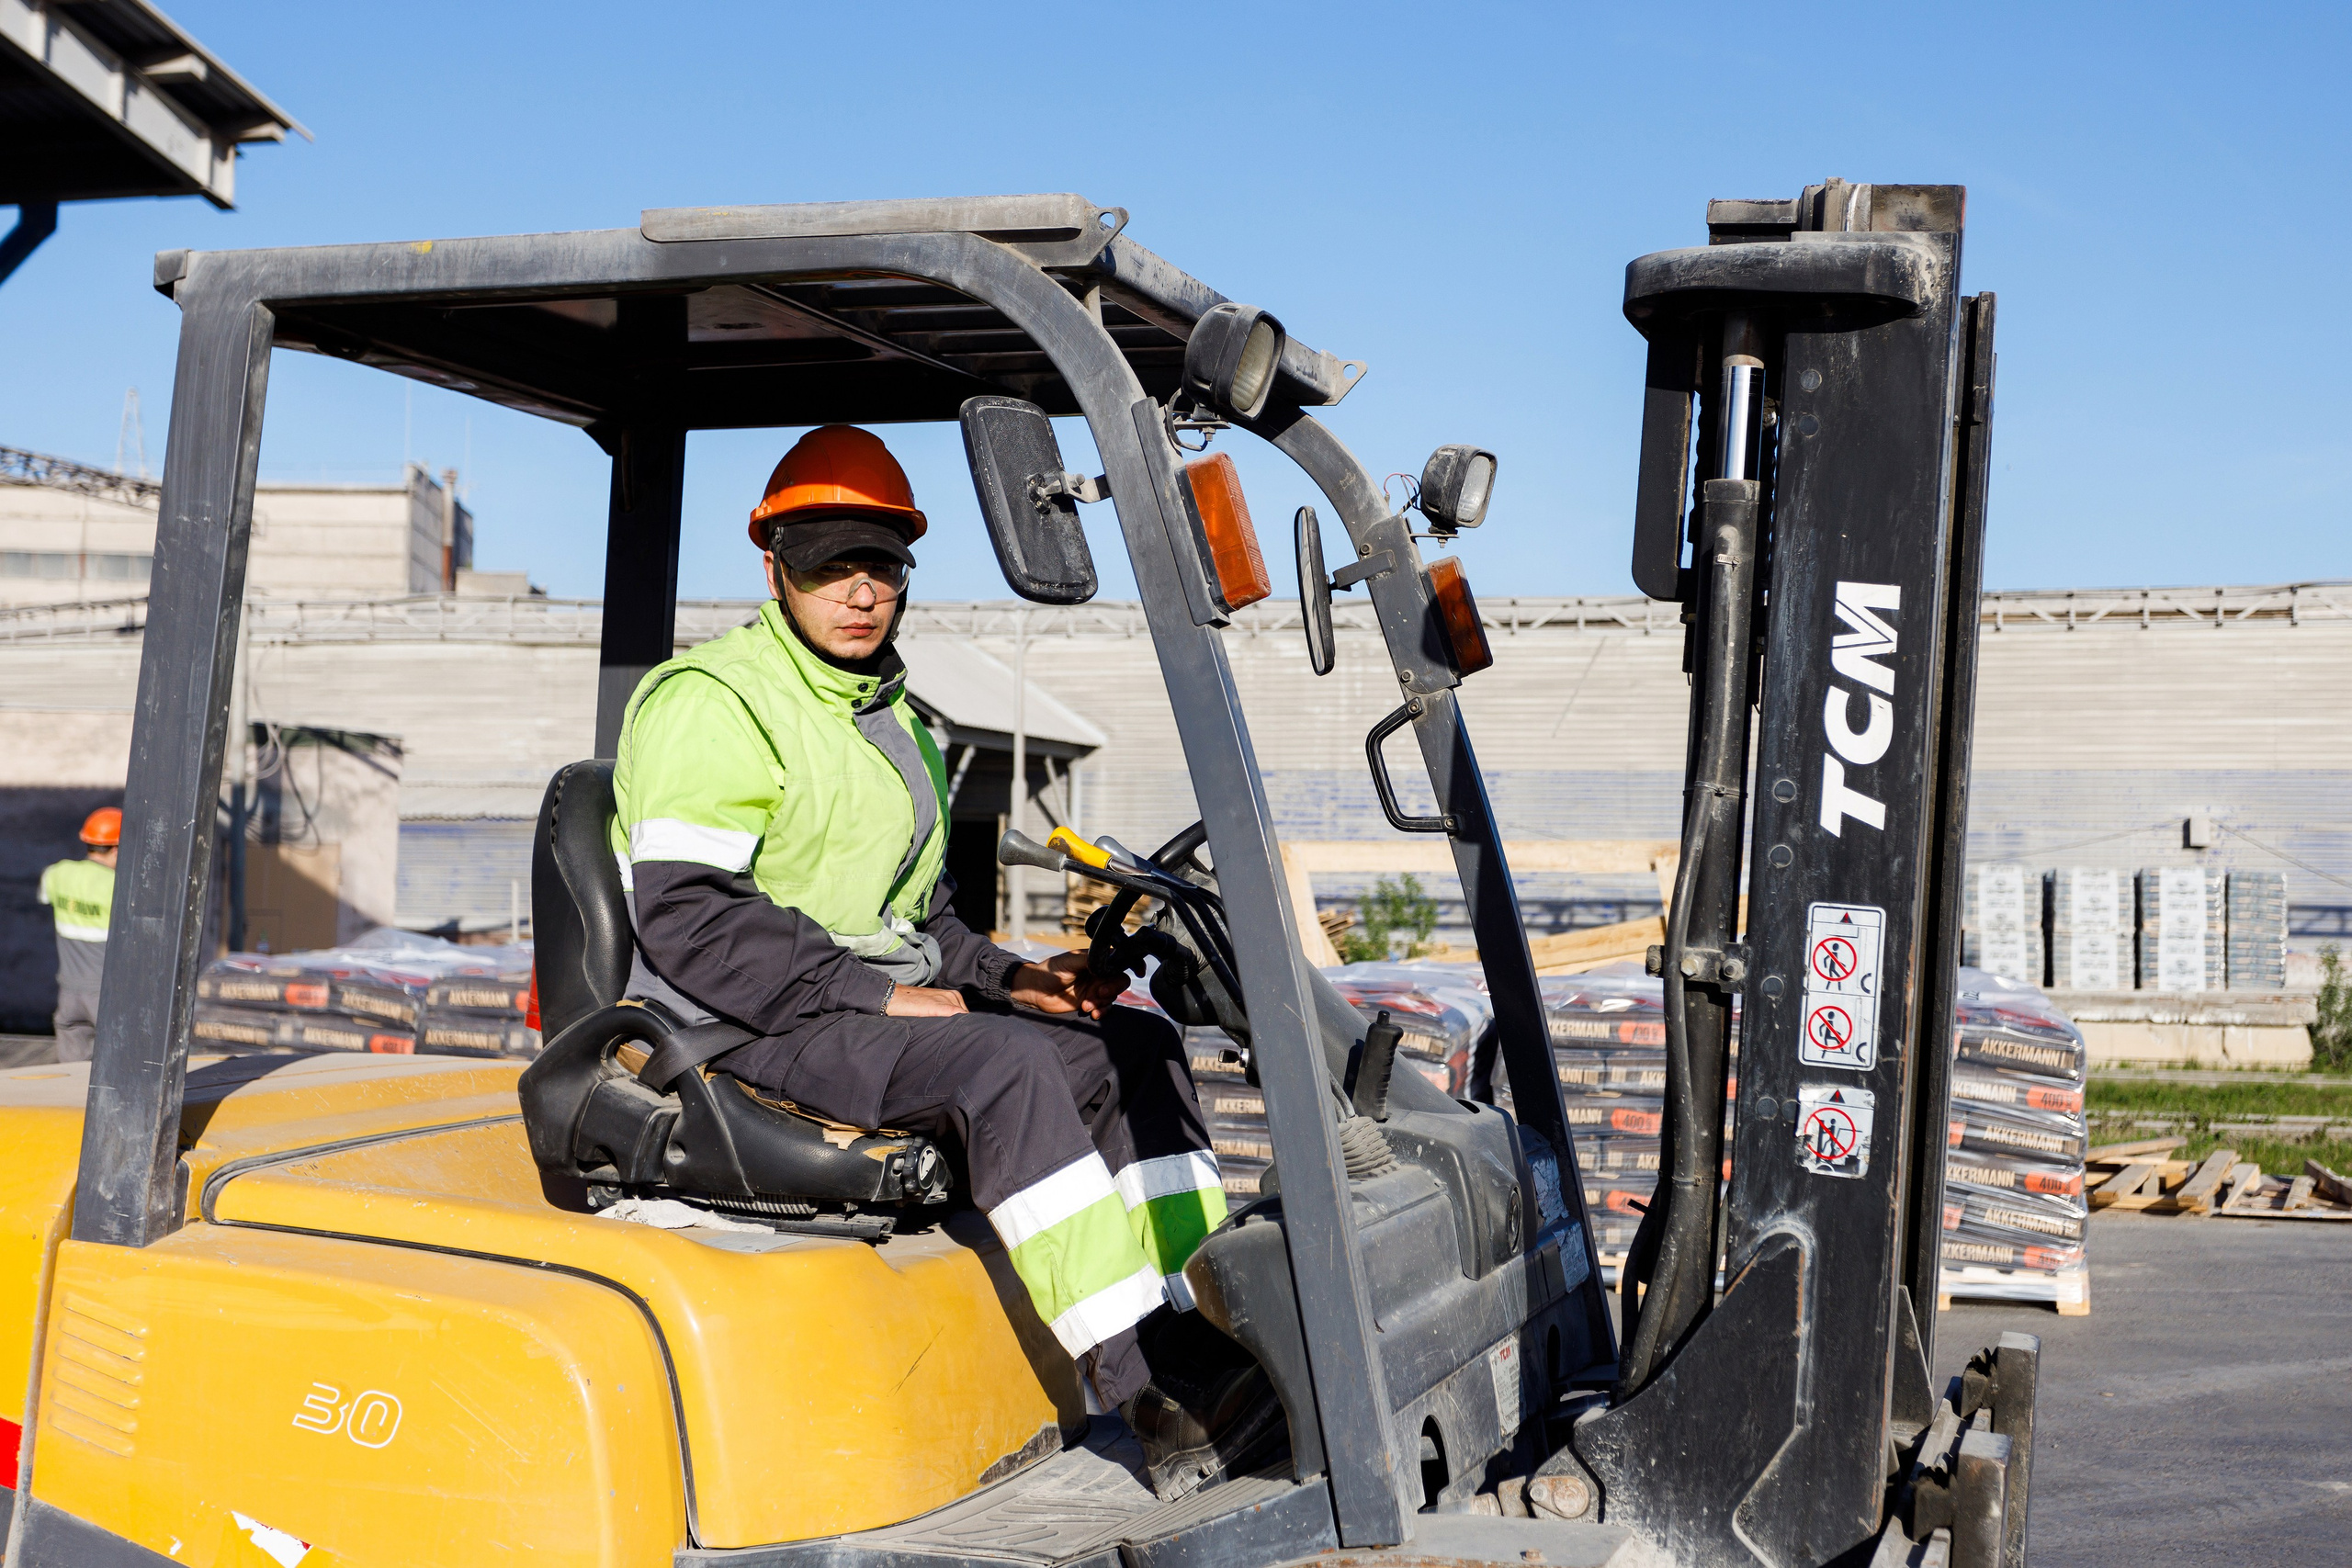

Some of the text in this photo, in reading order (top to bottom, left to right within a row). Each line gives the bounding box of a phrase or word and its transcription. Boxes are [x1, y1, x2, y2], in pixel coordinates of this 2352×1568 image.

[1820, 581, 1902, 839] TCM
[1980, 1036, 2060, 1067] AKKERMANN
[1214, 1098, 1265, 1114] AKKERM
[1984, 1125, 2064, 1153] AKKERMANN
[1946, 1166, 2016, 1188] KKERMANN
[1984, 1207, 2064, 1236] AKKERMANN
[291, 1381, 403, 1449] 30
